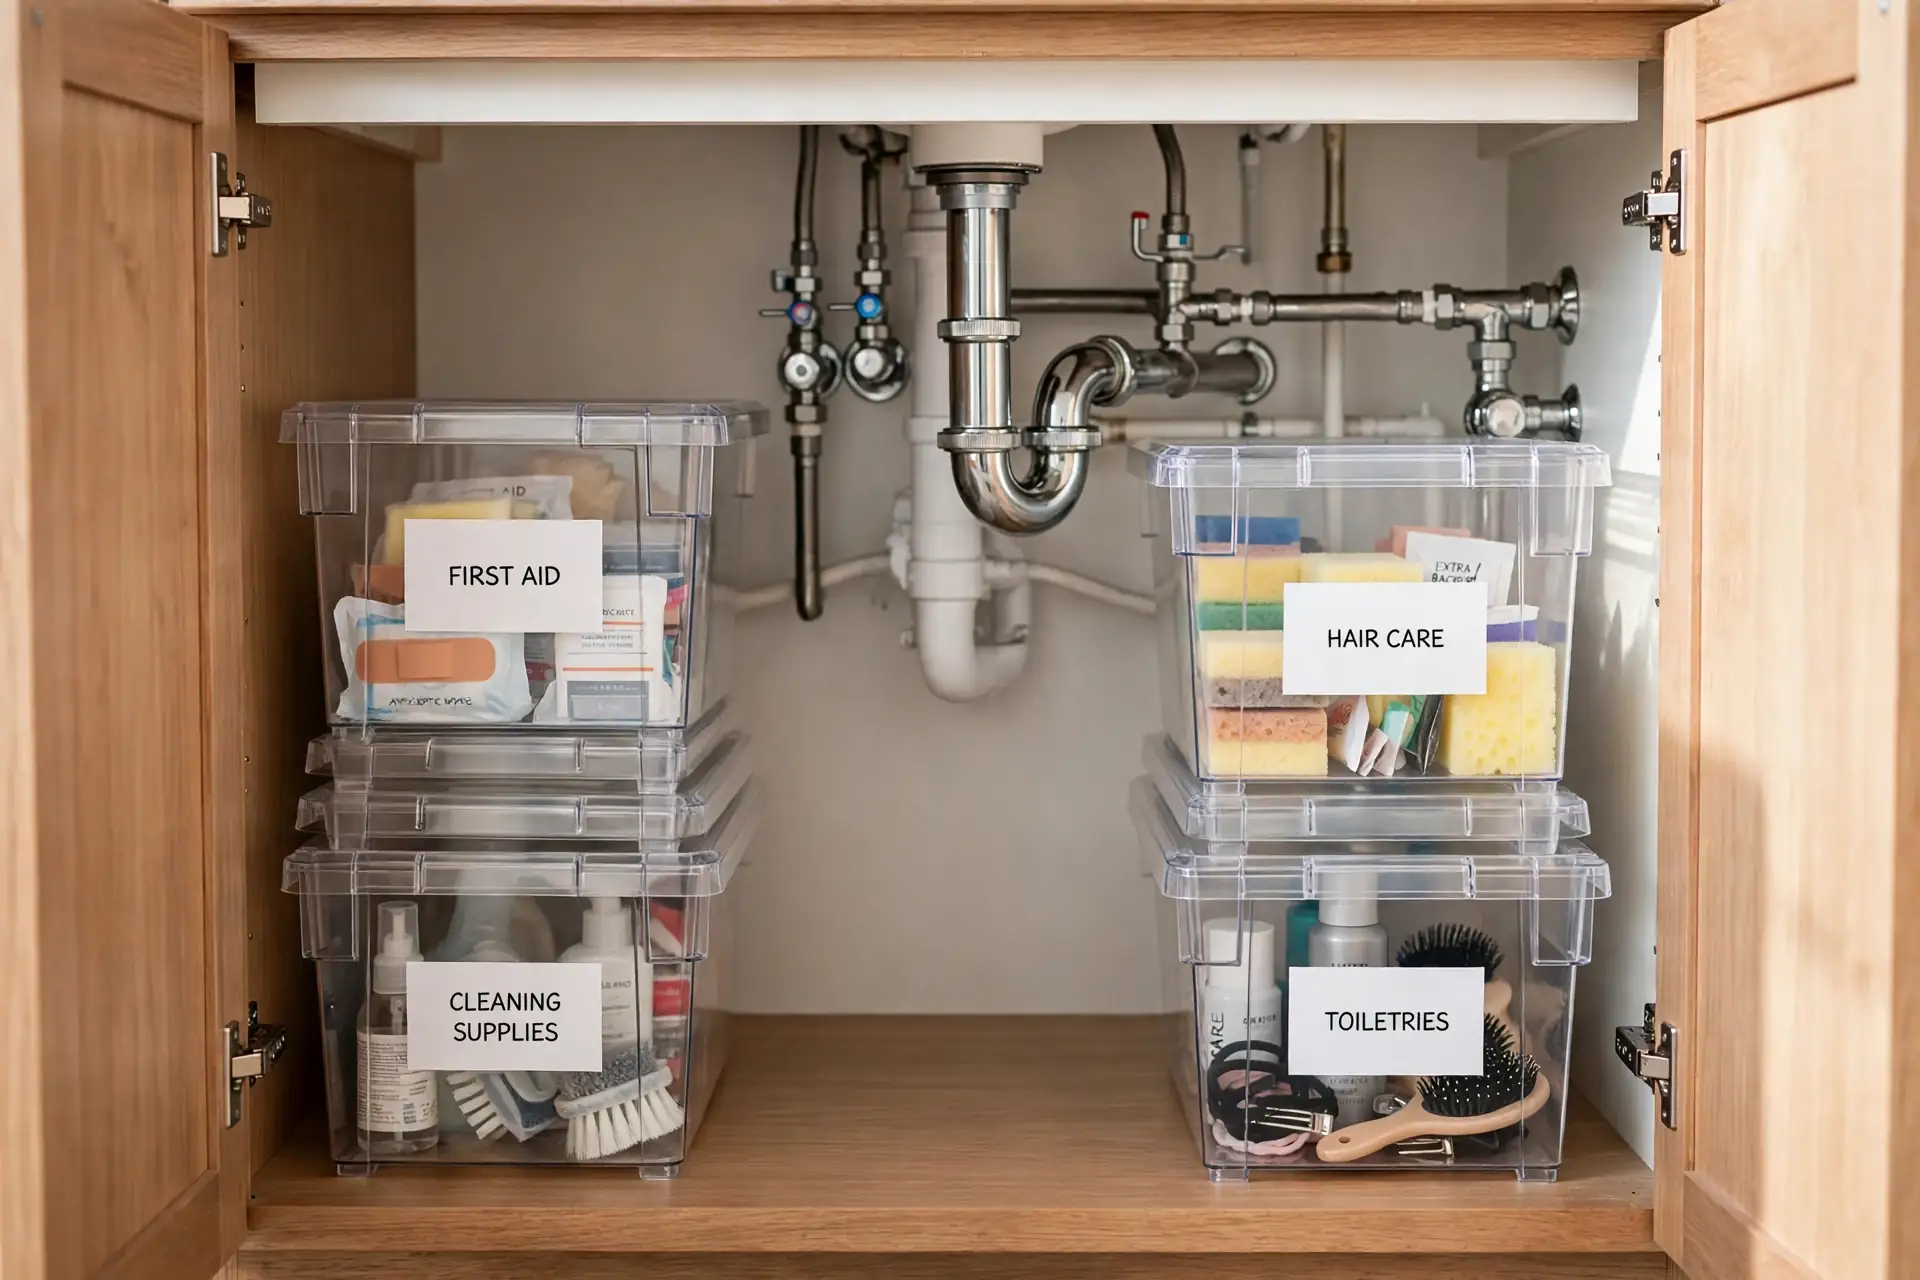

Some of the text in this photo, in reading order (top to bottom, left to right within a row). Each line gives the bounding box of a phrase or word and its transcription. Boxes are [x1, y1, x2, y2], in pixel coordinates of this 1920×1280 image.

[448, 565, 561, 587] FIRST AID
[1435, 561, 1471, 573] EXTRA
[1327, 628, 1445, 649] HAIR CARE
[449, 991, 561, 1012] CLEANING
[453, 1021, 559, 1042] SUPPLIES
[1324, 1011, 1450, 1032] TOILETRIES
